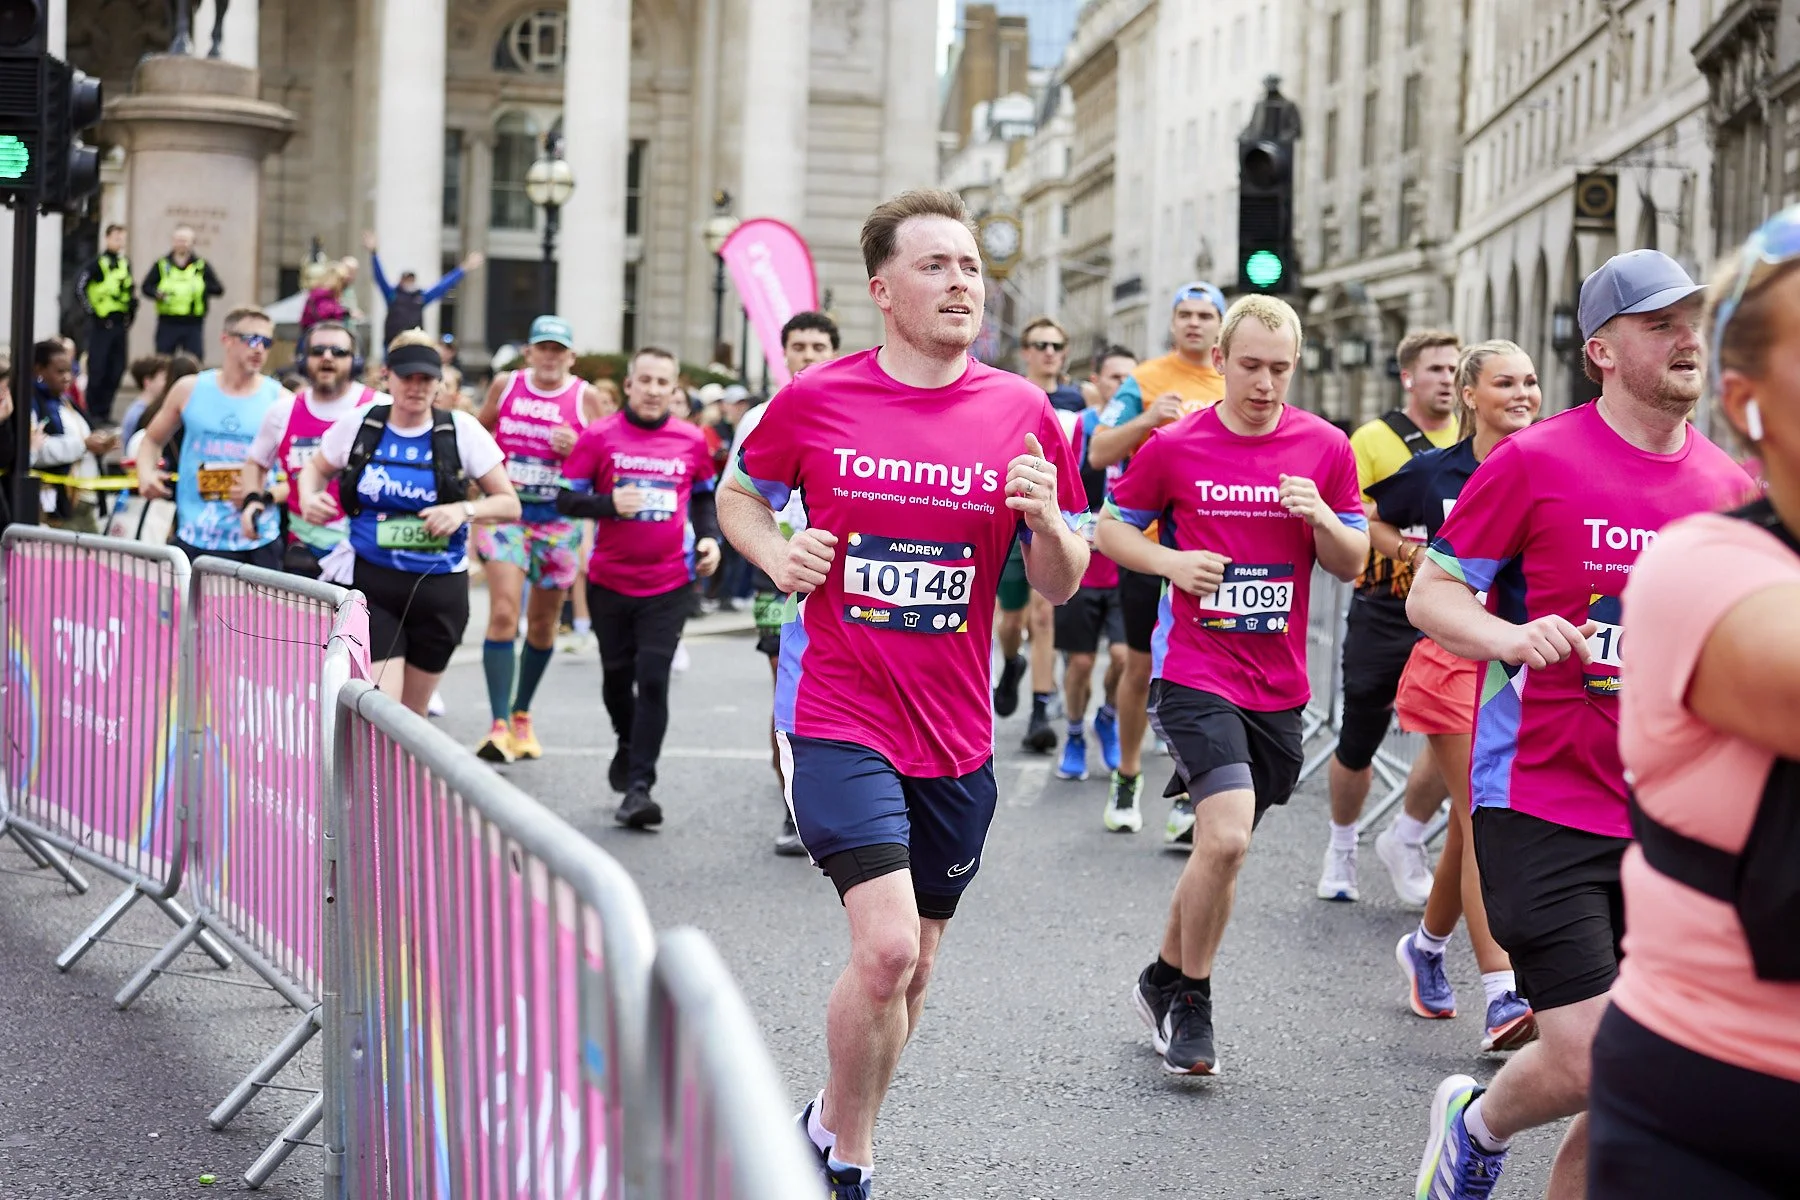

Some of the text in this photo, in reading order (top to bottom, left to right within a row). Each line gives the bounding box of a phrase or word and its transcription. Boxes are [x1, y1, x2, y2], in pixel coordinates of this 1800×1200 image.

[511, 397, 563, 424] NIGEL
[500, 416, 552, 443] Tomm
[833, 448, 998, 496] Tommy's
[832, 487, 995, 514] The pregnancy and baby charity
[1195, 480, 1280, 502] Tomm
[1197, 508, 1210, 516] The
[1211, 509, 1251, 518] pregnancy
[1268, 510, 1288, 519] baby
[1583, 518, 1660, 551] Tom
[889, 542, 943, 557] ANDREW
[1234, 568, 1269, 577] FRASER
[1583, 561, 1603, 571] The
[856, 562, 967, 601] 10148
[1214, 584, 1288, 608] 11093
